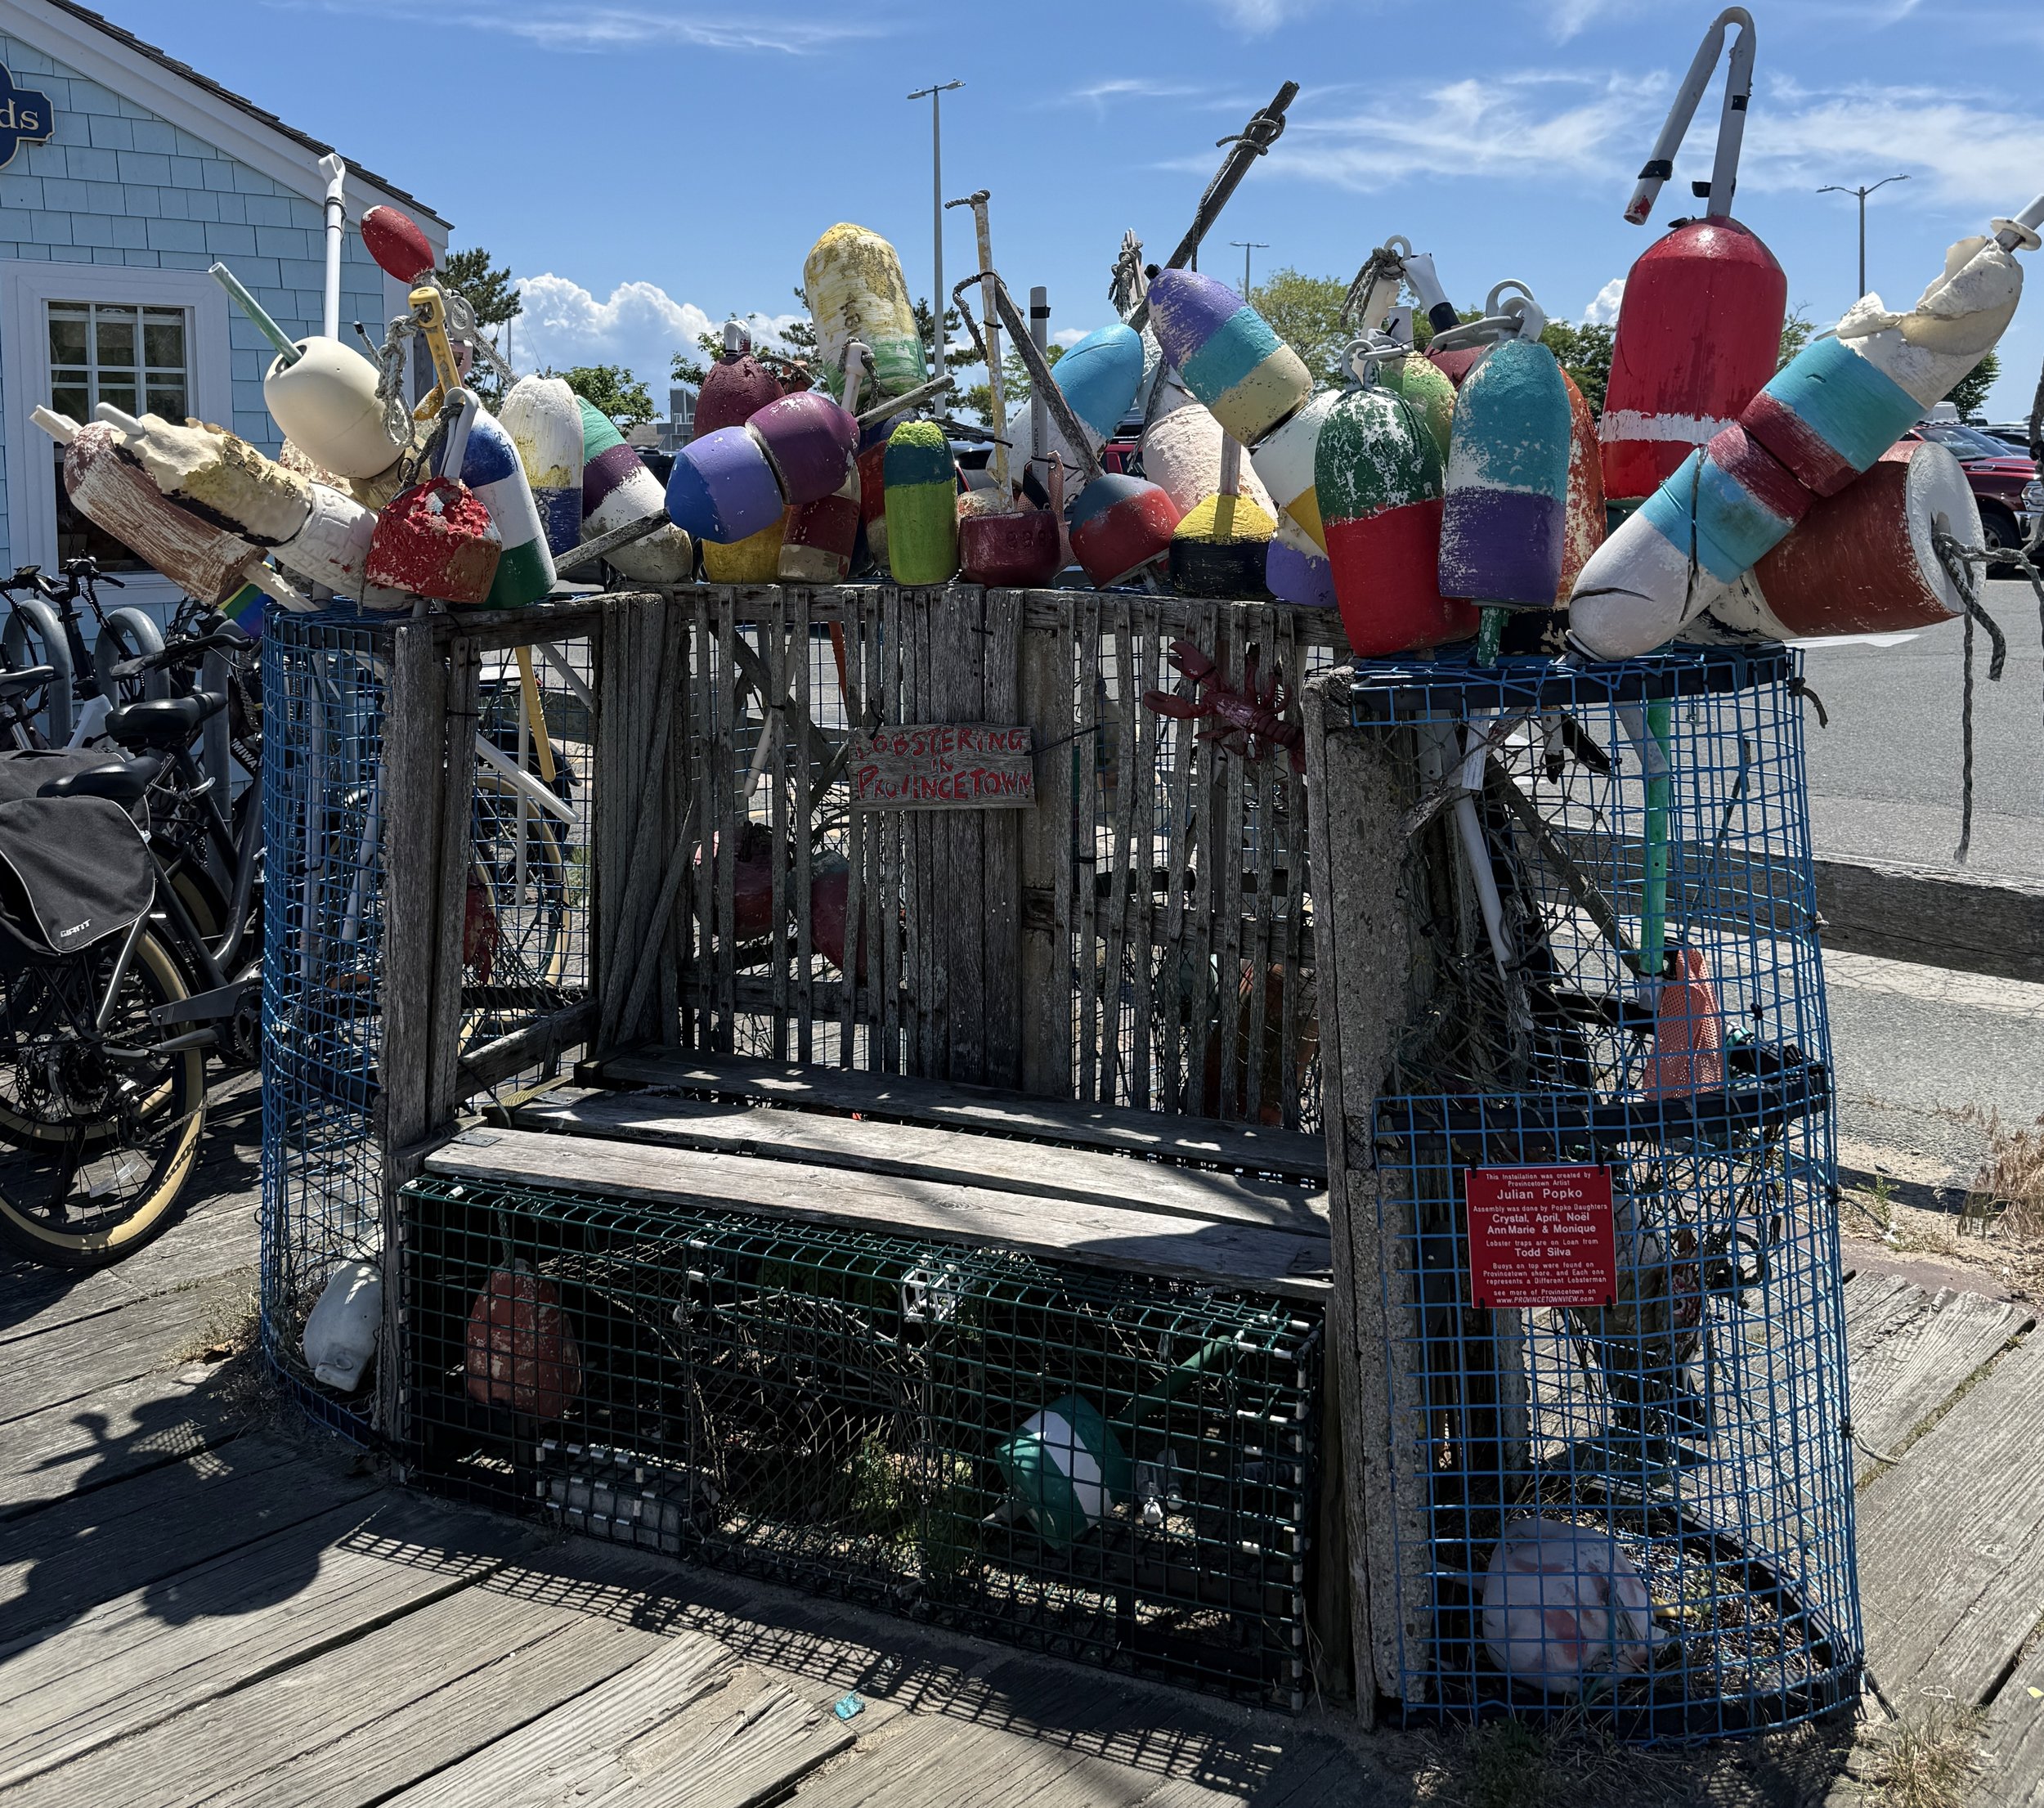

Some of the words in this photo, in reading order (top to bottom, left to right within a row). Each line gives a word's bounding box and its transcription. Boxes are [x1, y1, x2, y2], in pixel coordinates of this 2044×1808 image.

[854, 727, 1026, 760] LOBSTERING
[931, 756, 953, 774] IN
[858, 765, 1032, 800] PROVINCETOWN
[1497, 1190, 1534, 1200] Julian
[1544, 1188, 1583, 1200] Popko
[1574, 1204, 1607, 1212] Daughters
[1567, 1212, 1589, 1221] Noël
[1542, 1225, 1549, 1234] &
[1553, 1224, 1596, 1235] Monique
[1514, 1248, 1540, 1257] Todd
[1547, 1248, 1571, 1257] Silva
